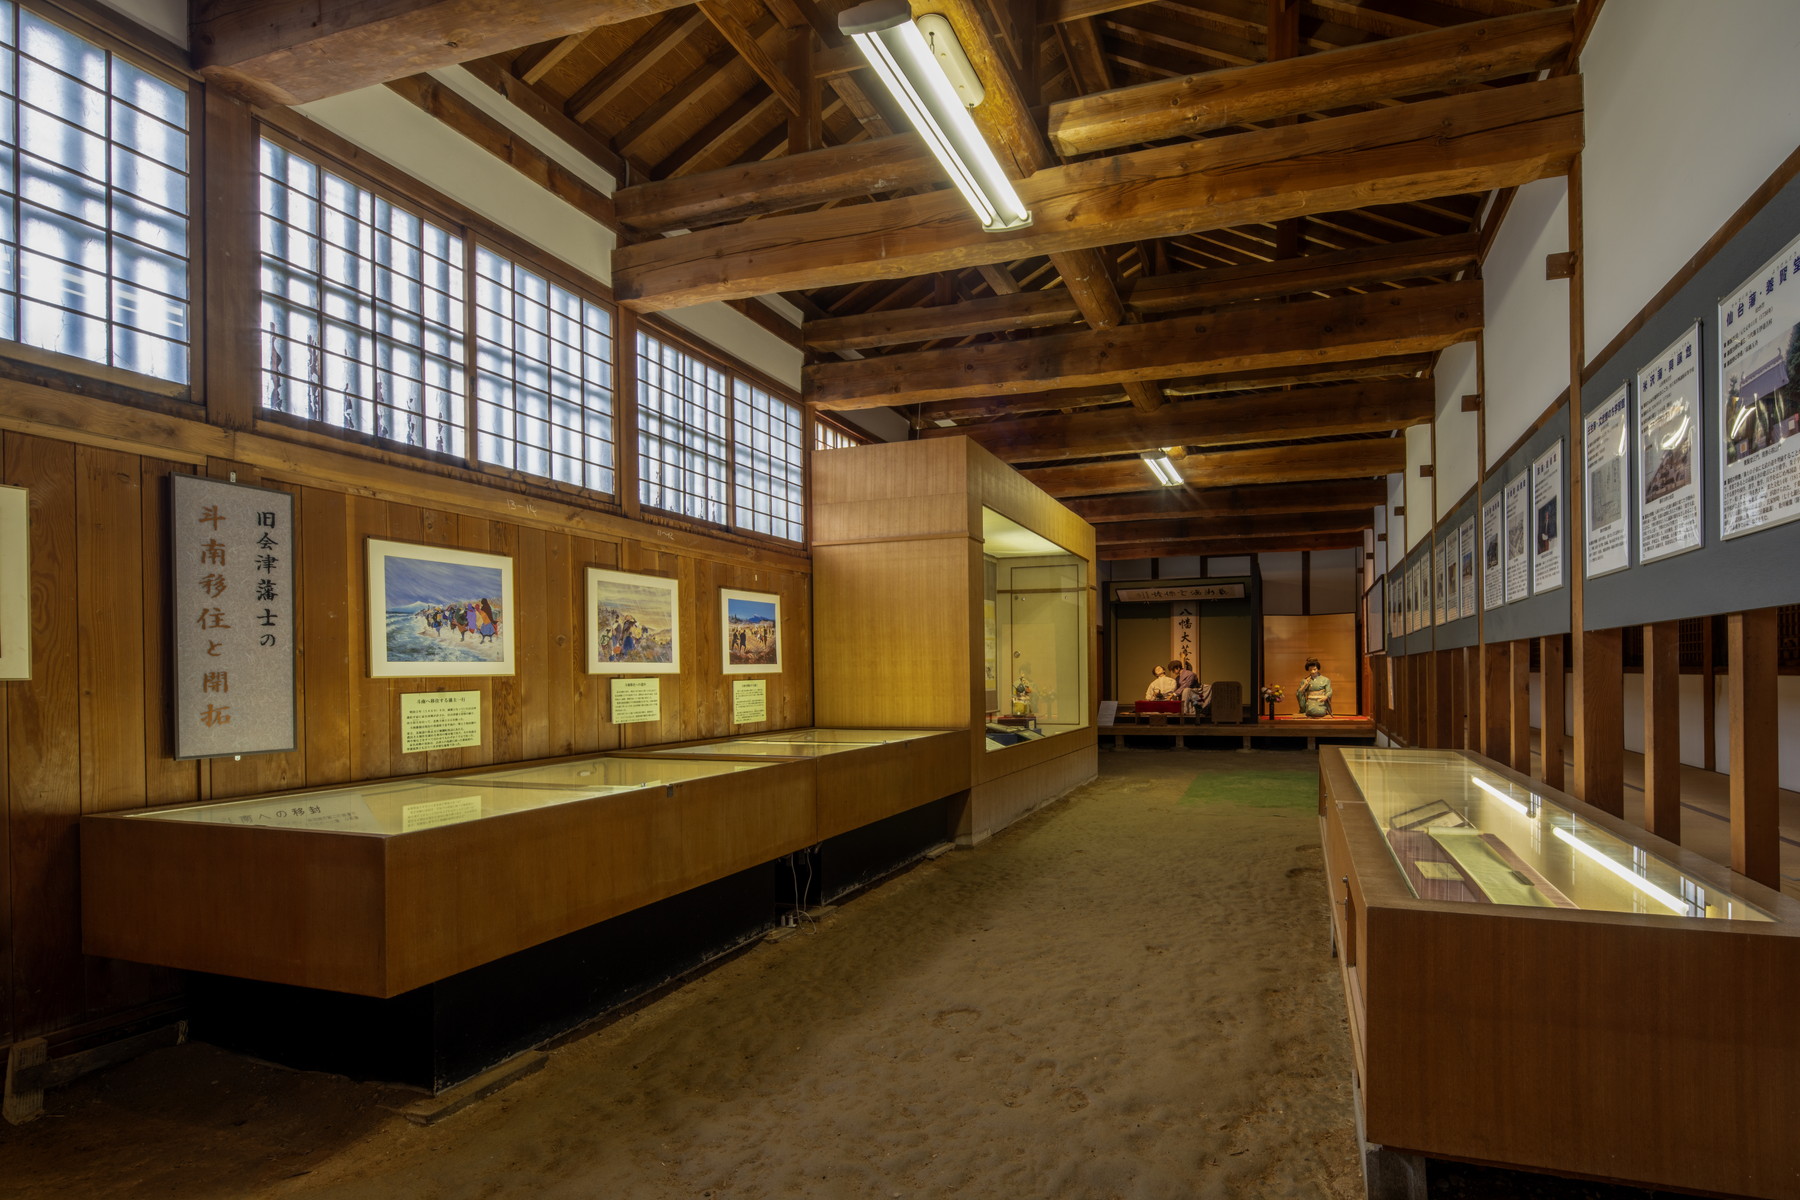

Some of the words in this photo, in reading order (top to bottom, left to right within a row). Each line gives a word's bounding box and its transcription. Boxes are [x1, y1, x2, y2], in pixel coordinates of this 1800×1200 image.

[196, 504, 231, 728] 斗南移住と開拓
[254, 510, 279, 648] 旧会津藩士の
